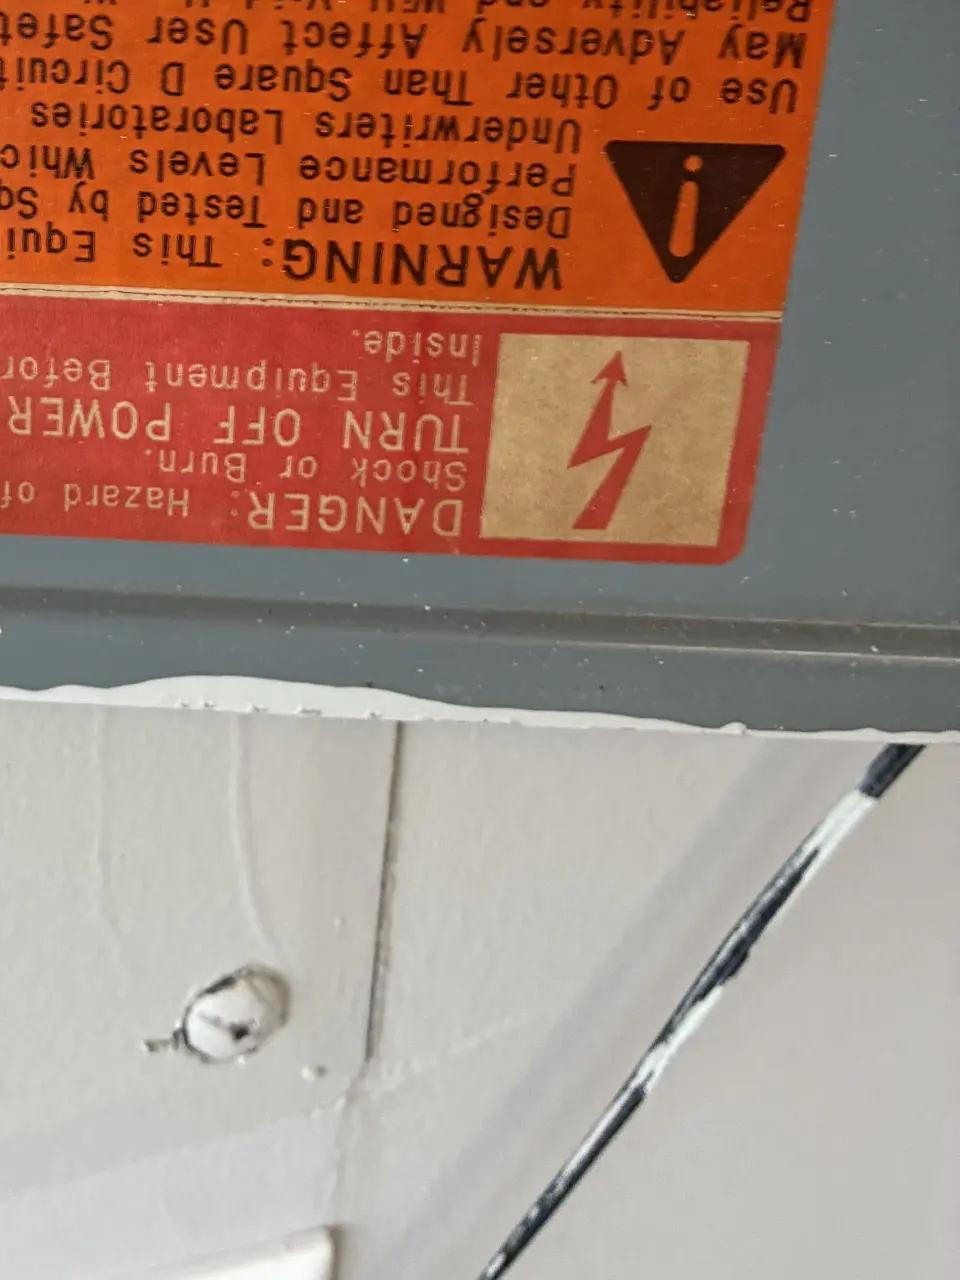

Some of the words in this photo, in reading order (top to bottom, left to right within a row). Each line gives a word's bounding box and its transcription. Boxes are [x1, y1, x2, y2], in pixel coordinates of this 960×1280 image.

[147, 16, 248, 55] User
[280, 19, 427, 59] Affect
[461, 18, 686, 66] Adversely
[718, 24, 807, 69] May
[161, 62, 184, 97] D
[214, 59, 352, 103] Square
[383, 68, 472, 107] Than
[506, 71, 618, 109] Other
[646, 75, 691, 112] of
[719, 78, 797, 114] Use
[31, 102, 283, 145] Laboratories
[315, 111, 581, 154] Underwriters
[129, 149, 266, 186] Levels
[299, 155, 577, 197] Performance
[68, 182, 108, 222] by
[137, 192, 267, 229] Tested
[297, 198, 364, 230] and
[392, 193, 571, 239] Designed
[133, 233, 222, 268] This
[261, 238, 562, 290] WARNING:
[352, 330, 482, 366] Inside.
[145, 360, 357, 401] Equipment
[392, 372, 473, 406] This
[8, 396, 170, 442] POWER
[213, 405, 300, 446] OFF
[343, 410, 469, 454] TURN
[145, 450, 246, 483] Burn.
[279, 456, 318, 478] or
[352, 458, 467, 492] Shock
[0, 480, 35, 508] of
[63, 483, 190, 517] Hazard
[229, 490, 463, 537] DANGER:
